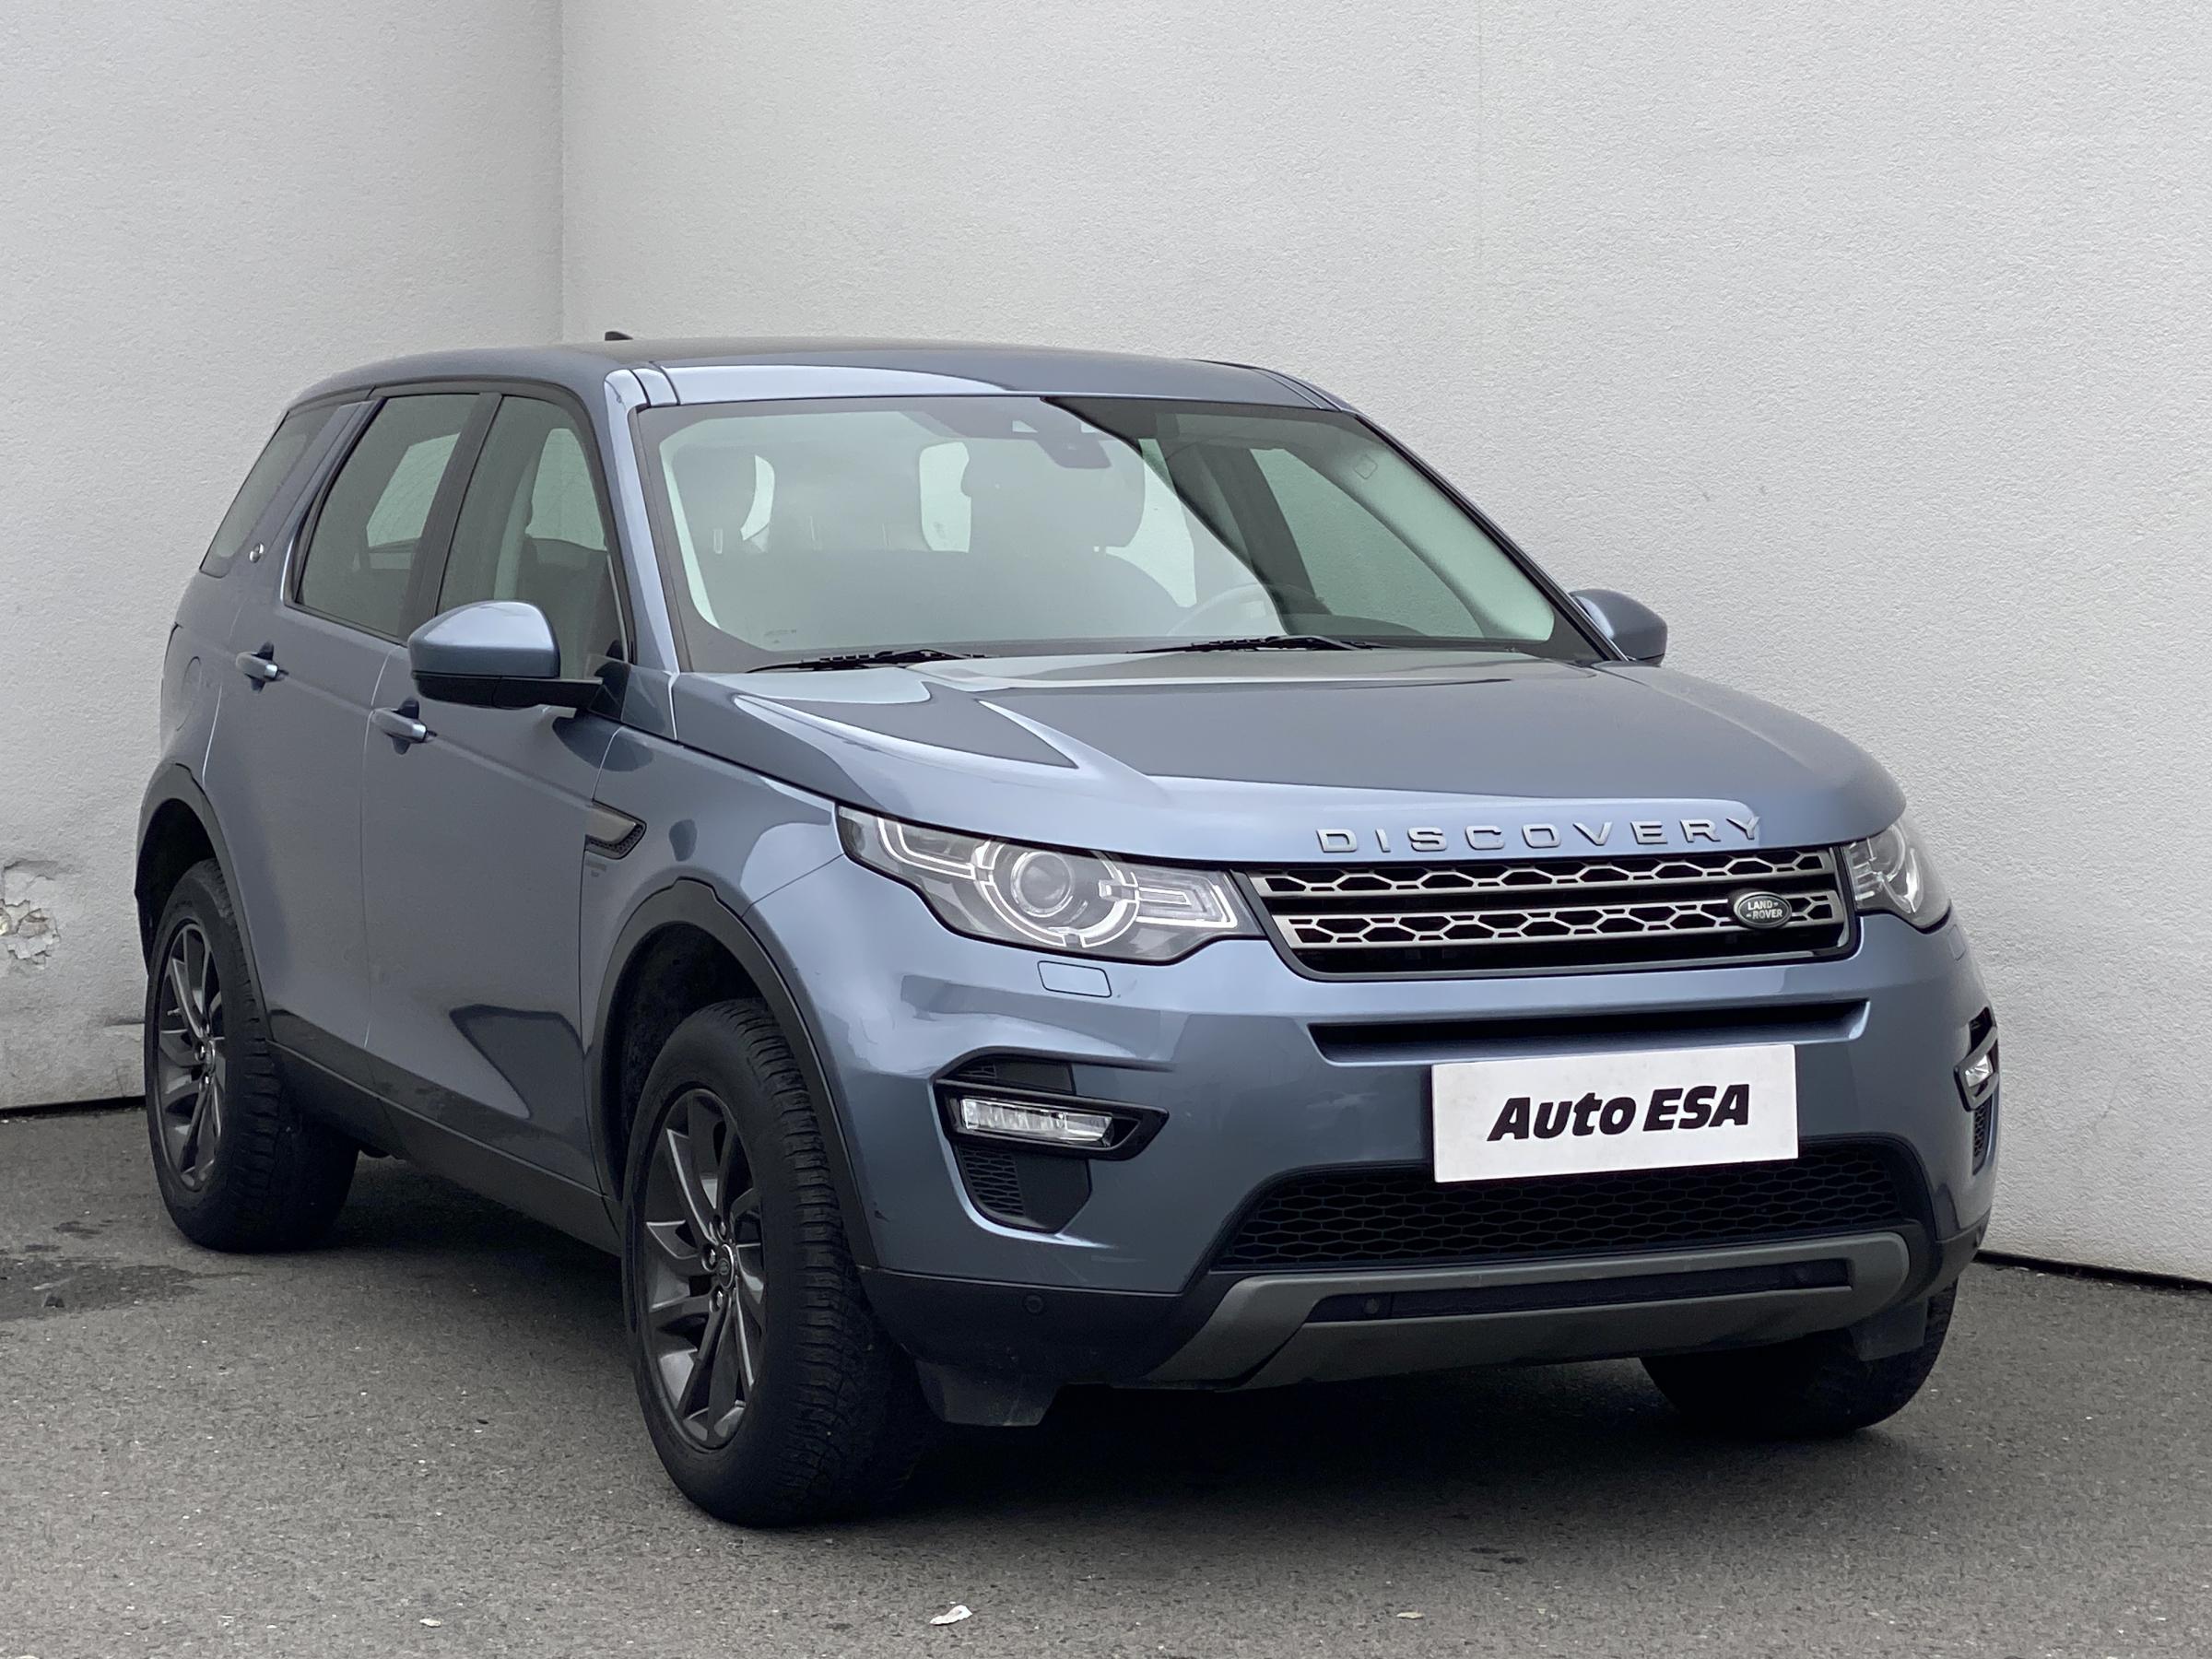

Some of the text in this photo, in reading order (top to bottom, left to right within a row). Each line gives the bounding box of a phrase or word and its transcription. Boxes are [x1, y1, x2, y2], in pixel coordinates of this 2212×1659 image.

[1317, 817, 1760, 853] DISCOVERY
[1747, 900, 1772, 911] LAND
[1752, 909, 1783, 920] ROVER
[1487, 1084, 1750, 1142] Auto ESA
